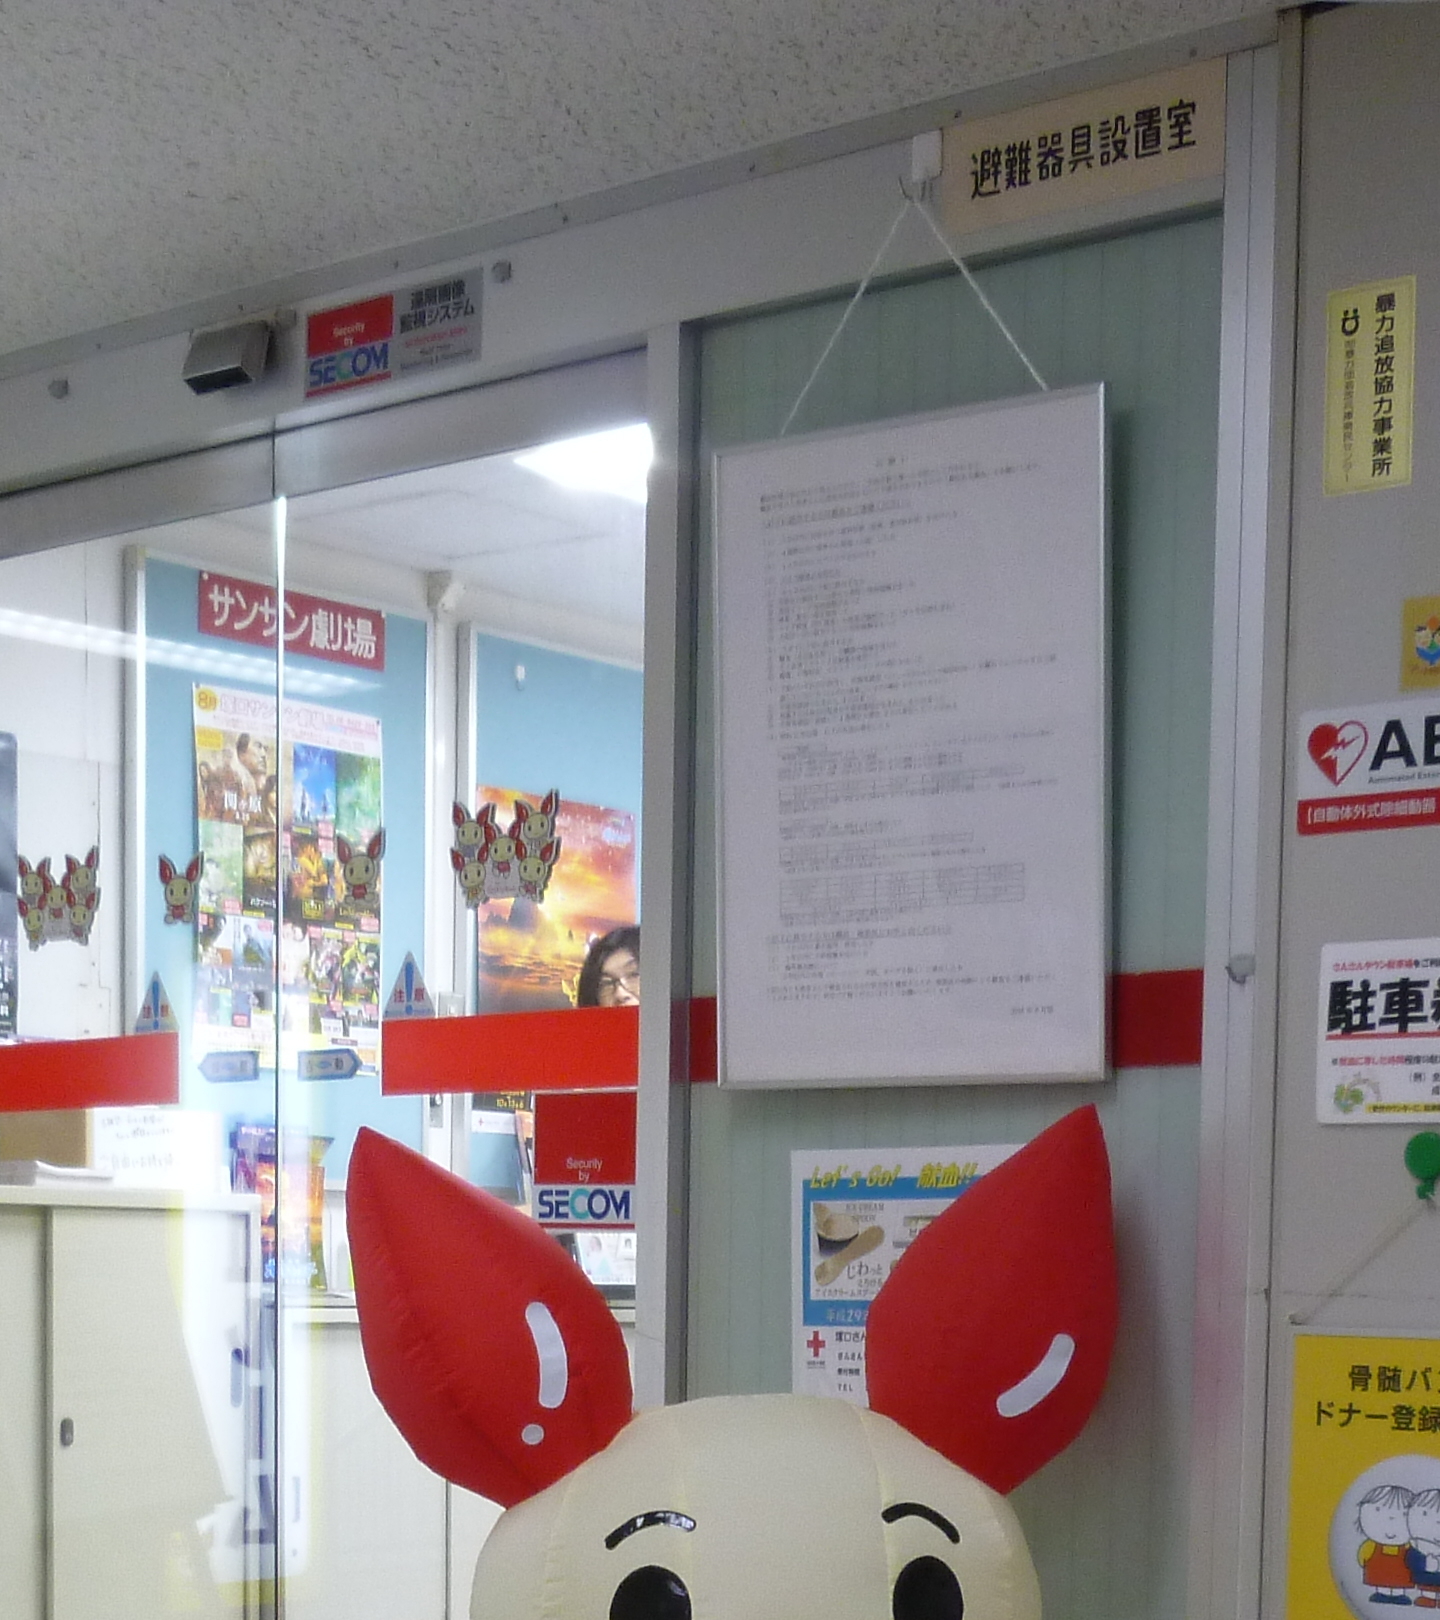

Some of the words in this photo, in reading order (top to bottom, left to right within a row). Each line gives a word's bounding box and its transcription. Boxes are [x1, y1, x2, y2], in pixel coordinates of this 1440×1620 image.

[970, 98, 1197, 201] 避難器具設置室
[309, 341, 390, 389] SECOM
[1372, 292, 1396, 478] 暴力追放協力事業所
[209, 583, 376, 659] サンサン劇場
[566, 1157, 603, 1171] Security
[578, 1170, 590, 1182] by
[538, 1188, 630, 1220] SECOM
